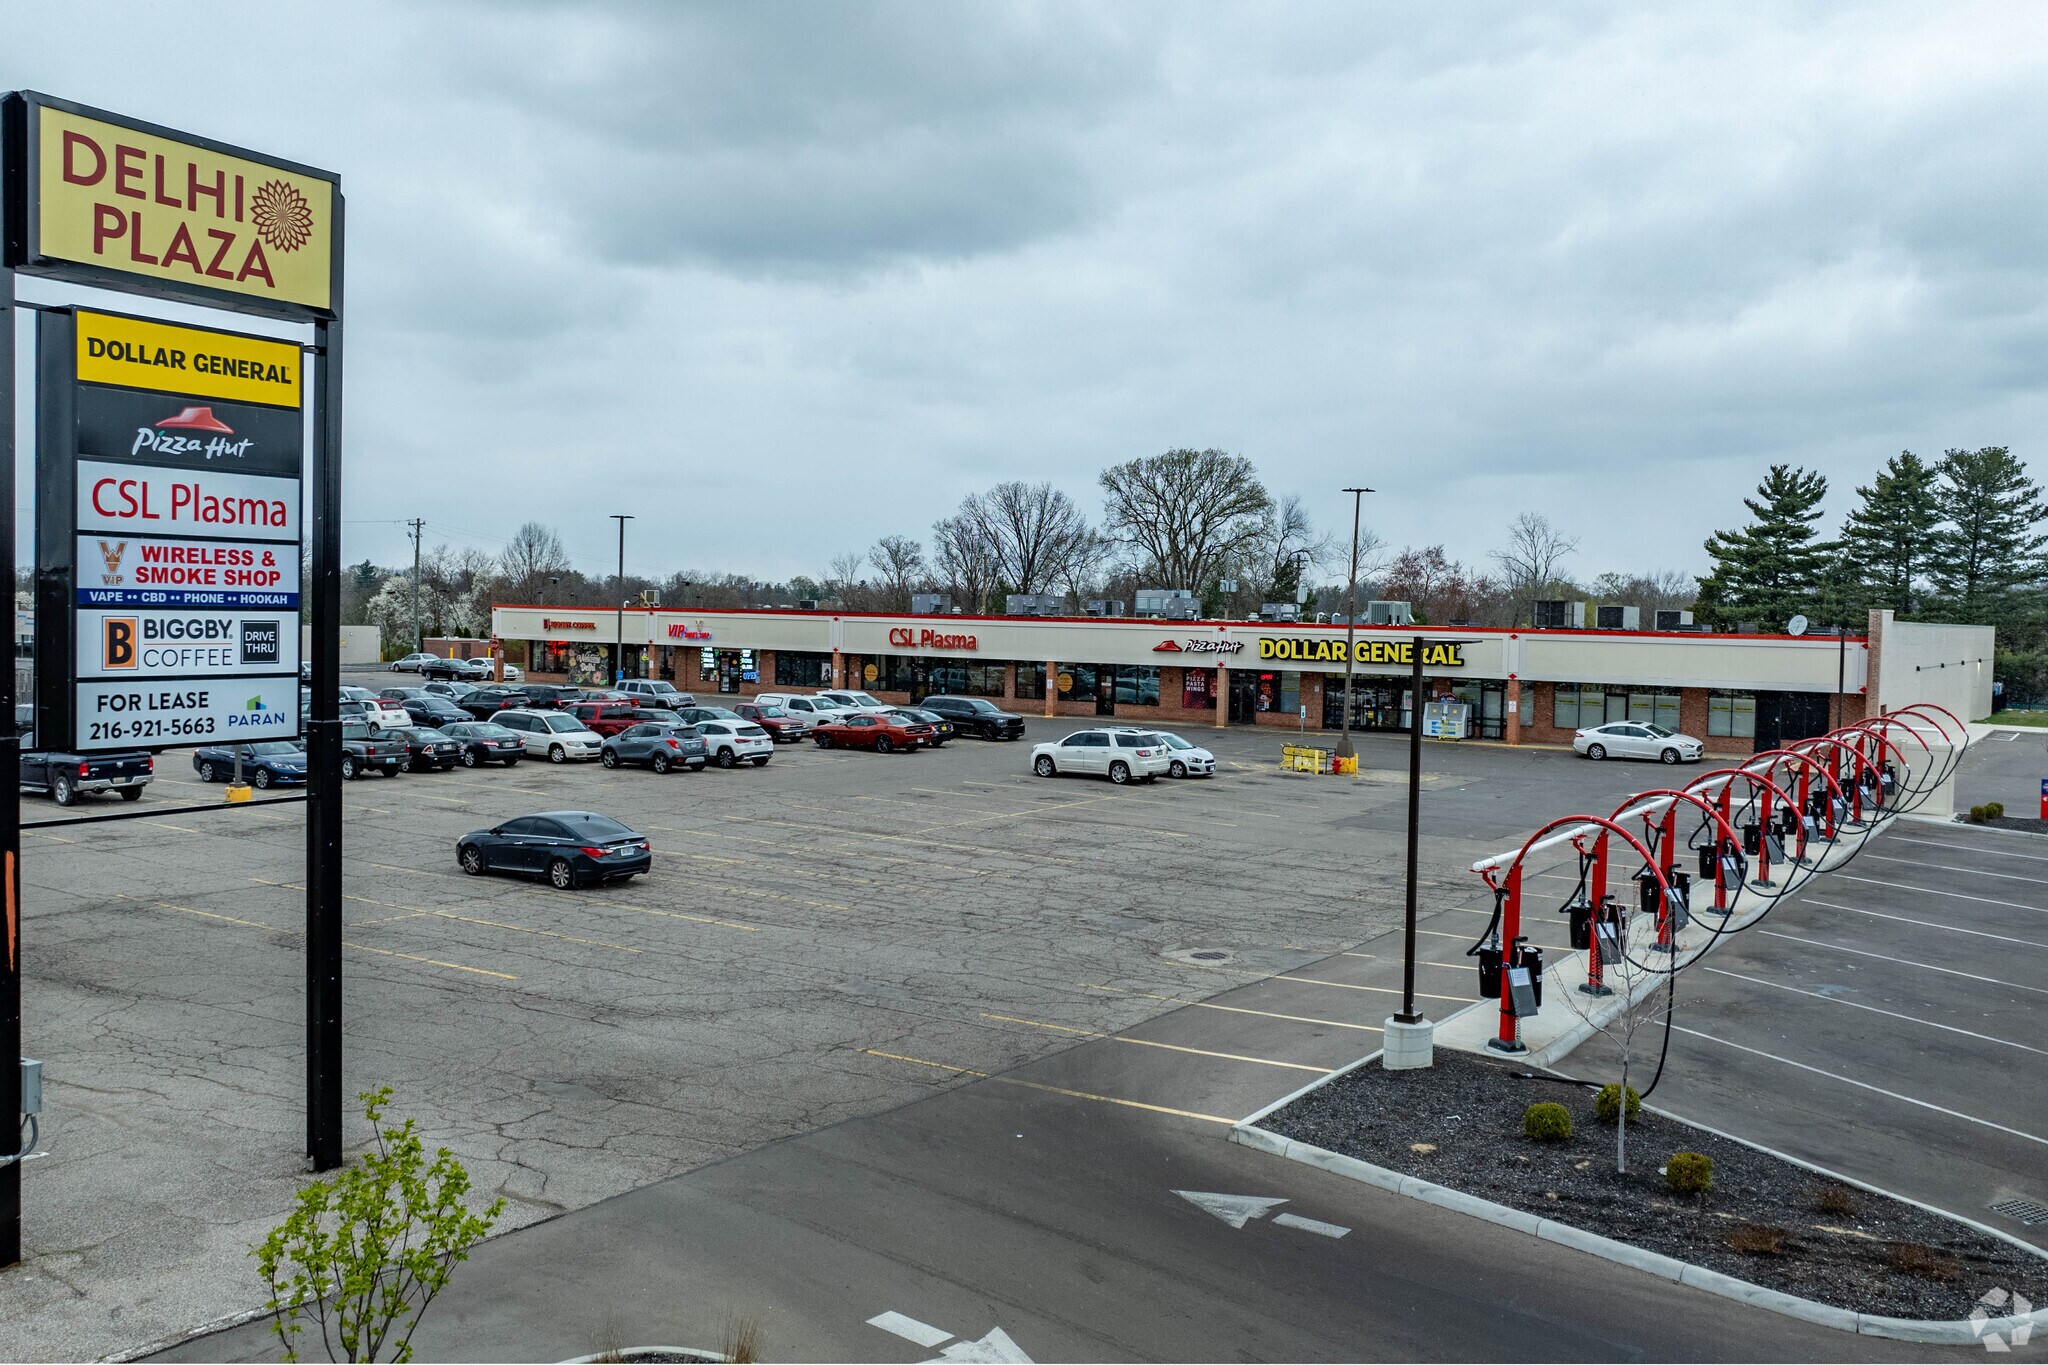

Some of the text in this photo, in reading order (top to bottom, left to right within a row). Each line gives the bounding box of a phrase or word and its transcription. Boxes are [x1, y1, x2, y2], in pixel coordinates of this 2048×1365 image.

[63, 130, 244, 223] DELHI
[93, 202, 275, 288] PLAZA
[87, 337, 292, 385] DOLLAR GENERAL
[131, 427, 254, 460] Pizza Hut
[92, 478, 287, 527] CSL Plasma
[141, 545, 276, 567] WIRELESS &
[101, 573, 124, 587] VIP
[135, 566, 281, 587] SMOKE SHOP
[89, 591, 287, 605] VAPE CBD PHONE HOOKAH
[144, 618, 233, 640] BIGGBY
[245, 631, 275, 641] DRIVE
[668, 624, 685, 638] VIP
[889, 627, 978, 650] CSL Plasma
[108, 622, 132, 665] B
[245, 643, 275, 654] THRU
[1184, 639, 1244, 654] Pizza Hut
[1259, 638, 1347, 661] DOLLAR
[144, 649, 233, 667] COFFEE
[97, 691, 209, 712] FOR LEASE
[89, 717, 215, 741] 216-921-5663
[228, 712, 285, 727] PARAN
